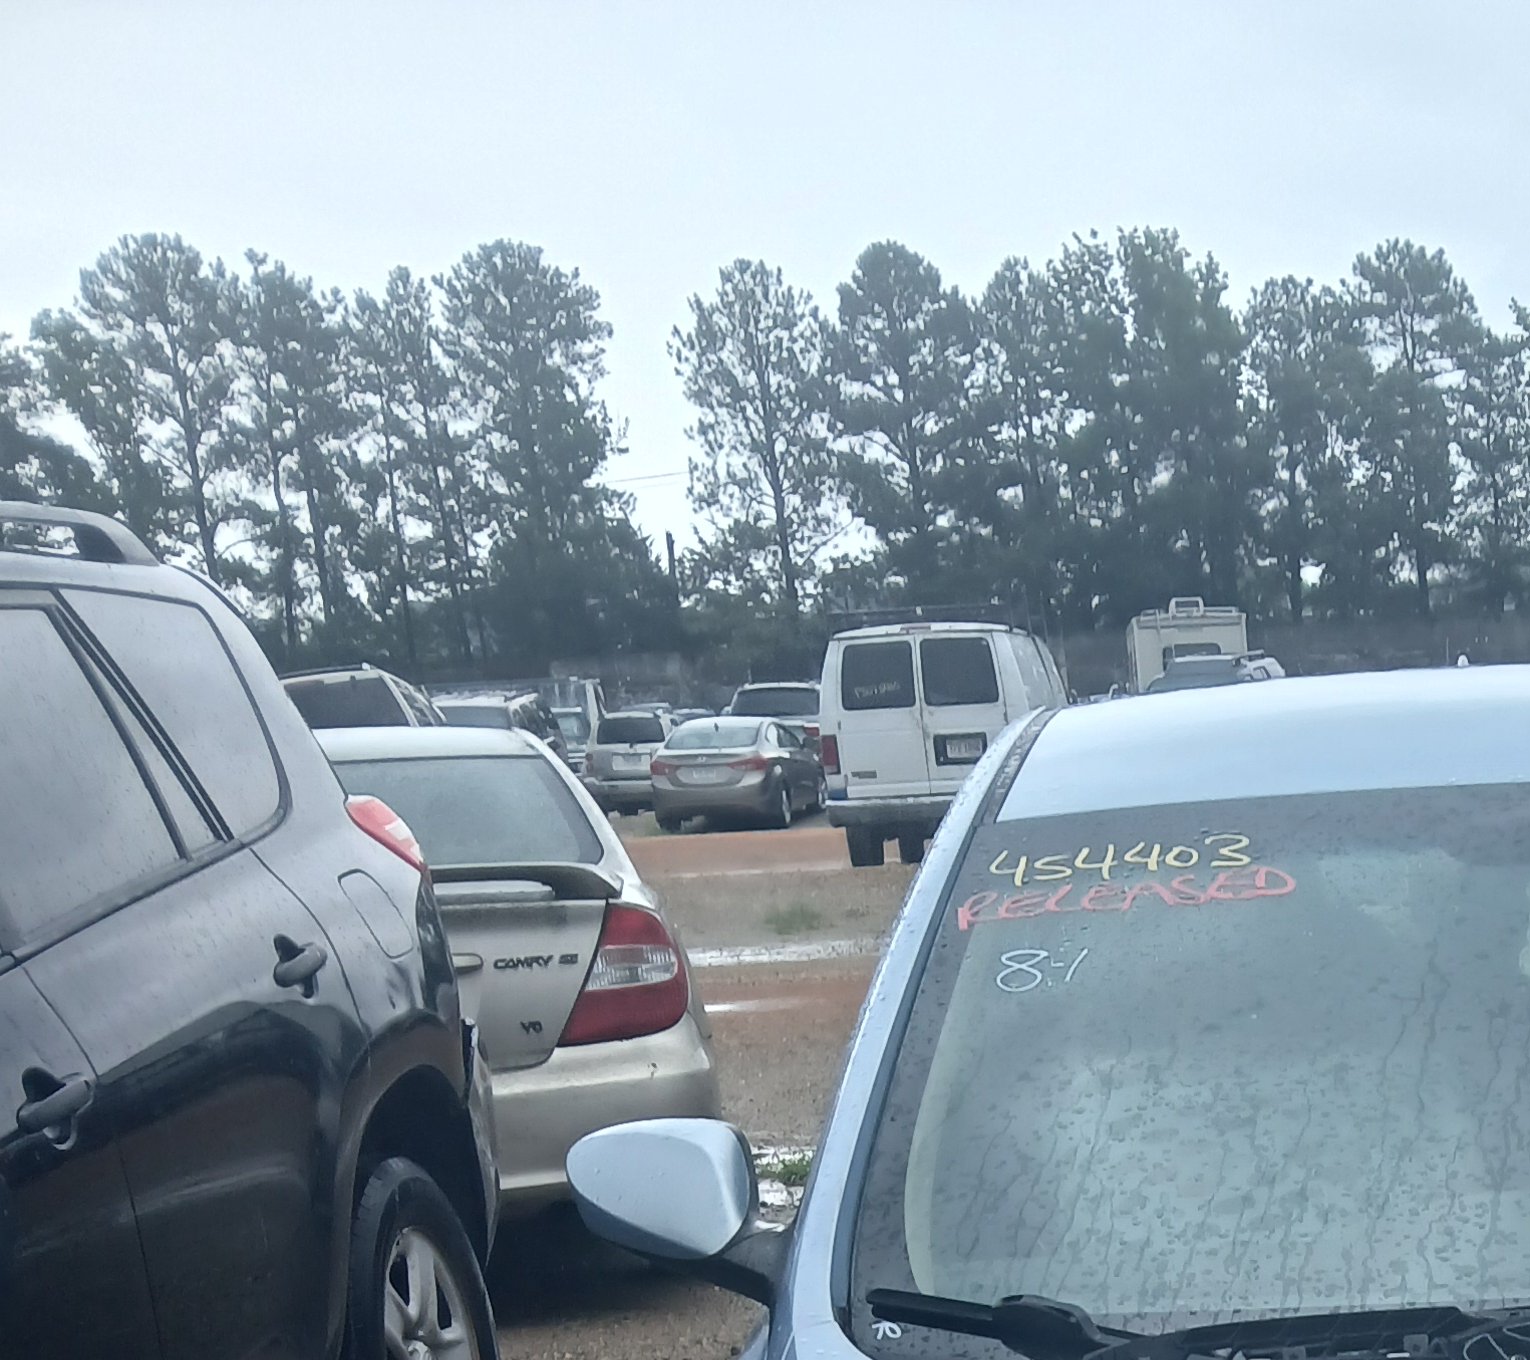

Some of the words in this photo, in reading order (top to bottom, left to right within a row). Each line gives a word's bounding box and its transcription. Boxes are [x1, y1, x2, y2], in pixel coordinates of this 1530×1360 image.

[989, 833, 1251, 886] 454403
[957, 866, 1297, 930] RELEASED
[493, 954, 554, 970] CAMRY
